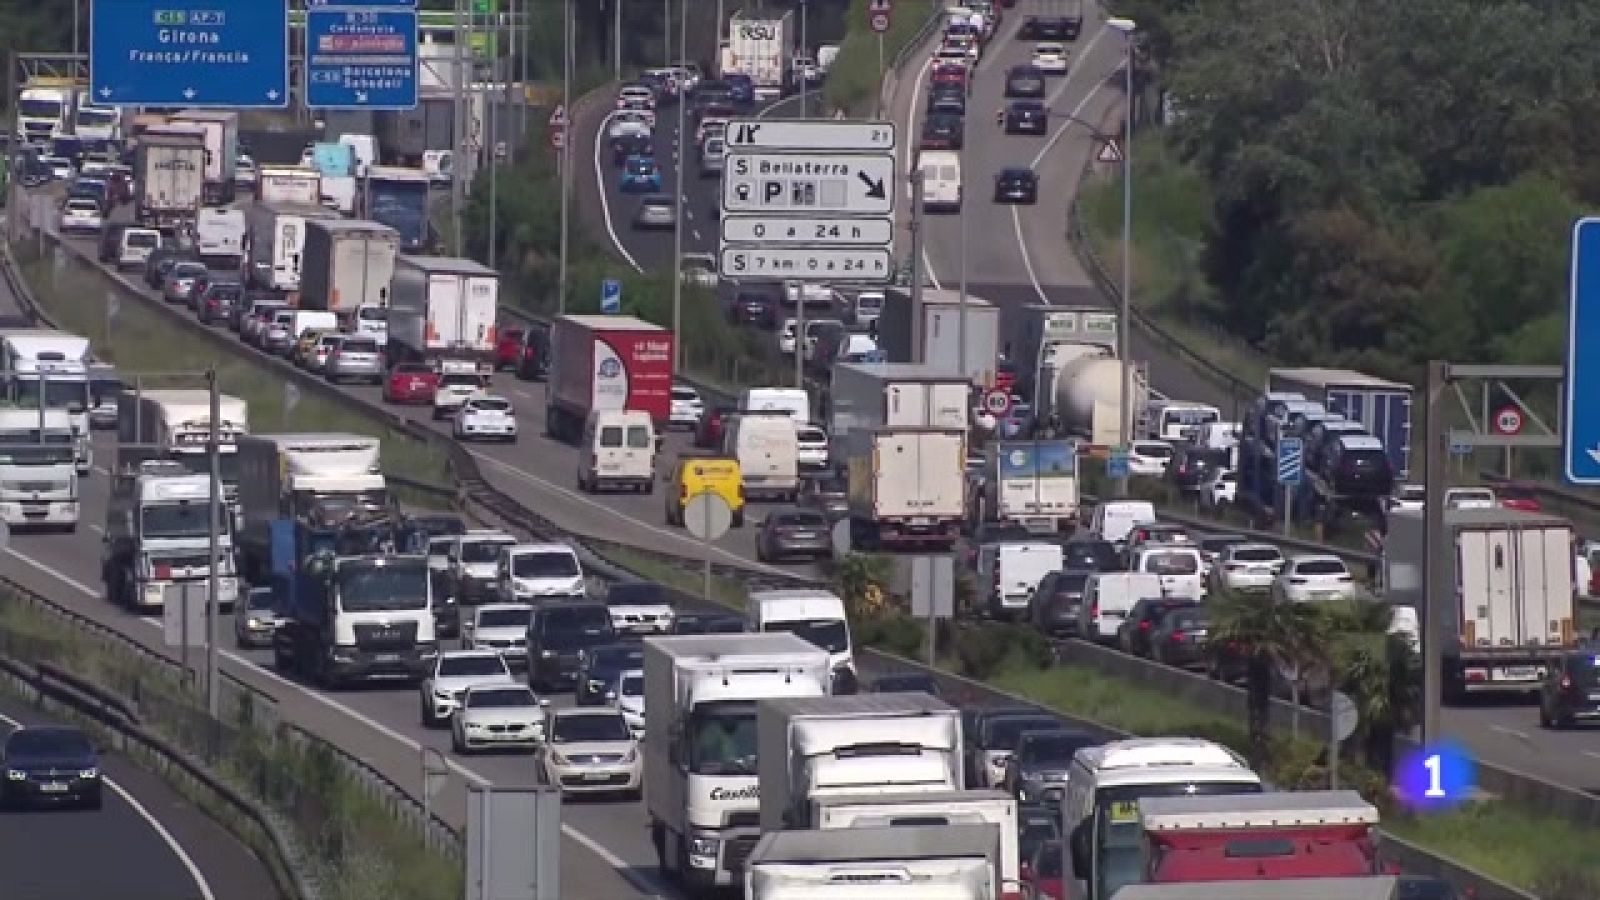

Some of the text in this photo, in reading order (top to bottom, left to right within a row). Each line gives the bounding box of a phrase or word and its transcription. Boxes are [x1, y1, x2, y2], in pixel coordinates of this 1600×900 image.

[158, 29, 220, 44] Girona
[735, 160, 848, 175] S Bellaterra
[765, 182, 782, 204] P
[754, 224, 861, 238] 0 a 24 h
[735, 254, 746, 270] S
[755, 257, 766, 268] 7
[827, 259, 835, 269] a
[843, 259, 865, 269] 24
[875, 259, 883, 269] h
[1501, 416, 1517, 426] 80
